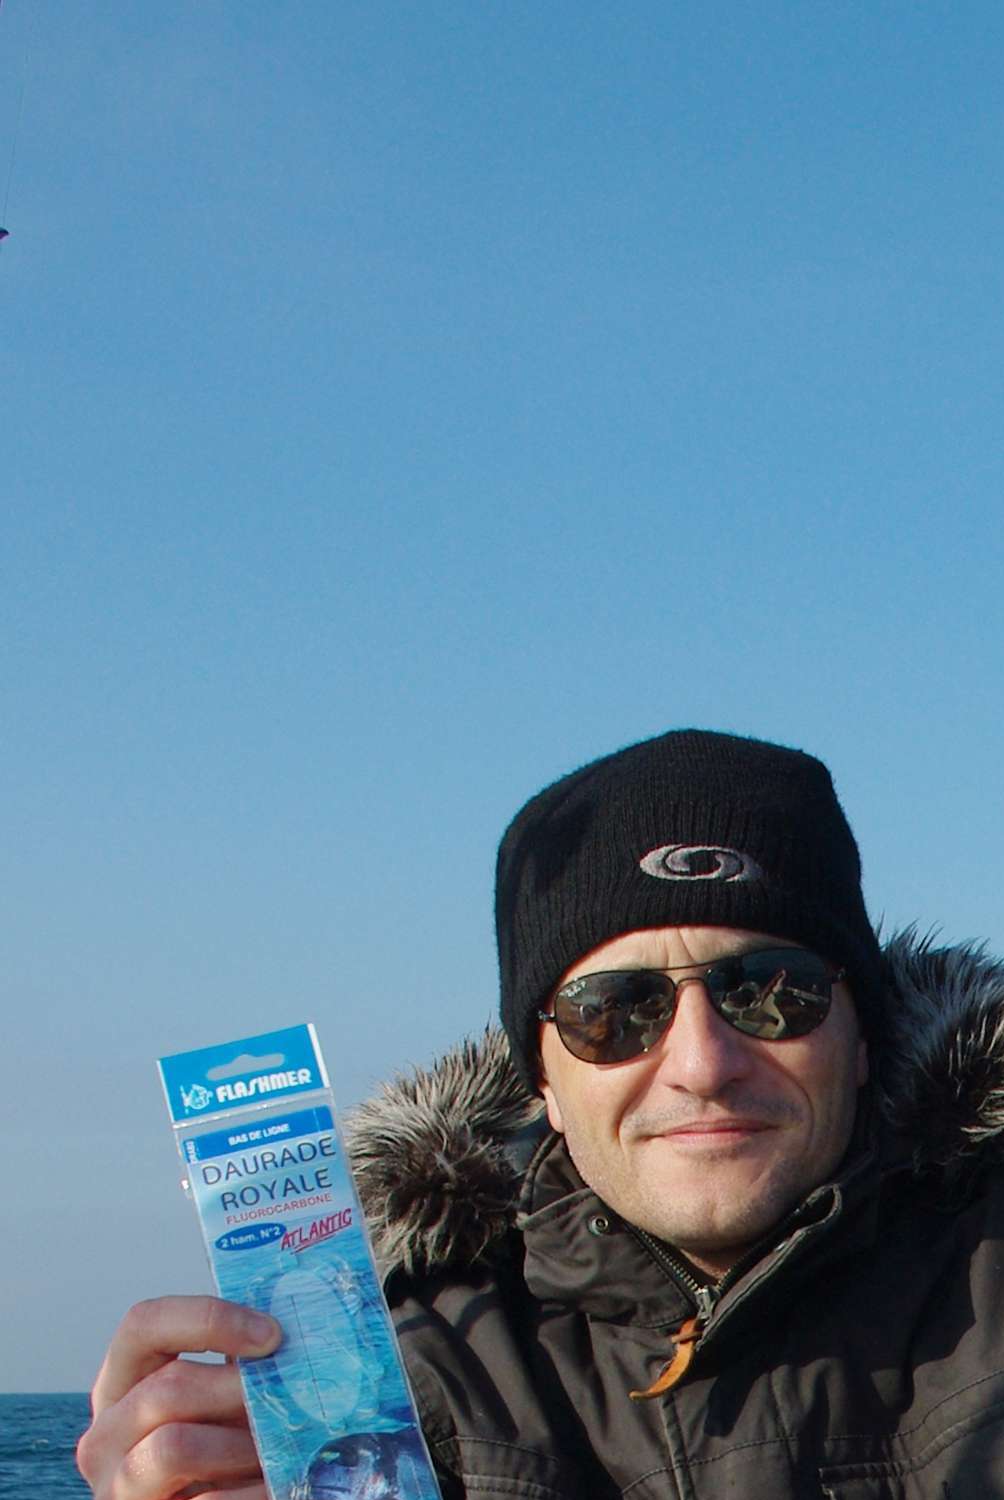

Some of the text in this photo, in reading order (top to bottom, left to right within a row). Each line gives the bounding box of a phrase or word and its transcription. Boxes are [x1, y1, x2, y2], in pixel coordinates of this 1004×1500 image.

[216, 1068, 312, 1103] FLASHMER
[228, 1124, 290, 1146] BAS DE LIGNE
[202, 1136, 336, 1185] DAURADE
[221, 1168, 333, 1211] ROYALE
[226, 1192, 333, 1225] FLUOROCARBONE
[281, 1208, 353, 1251] ATLANTIC
